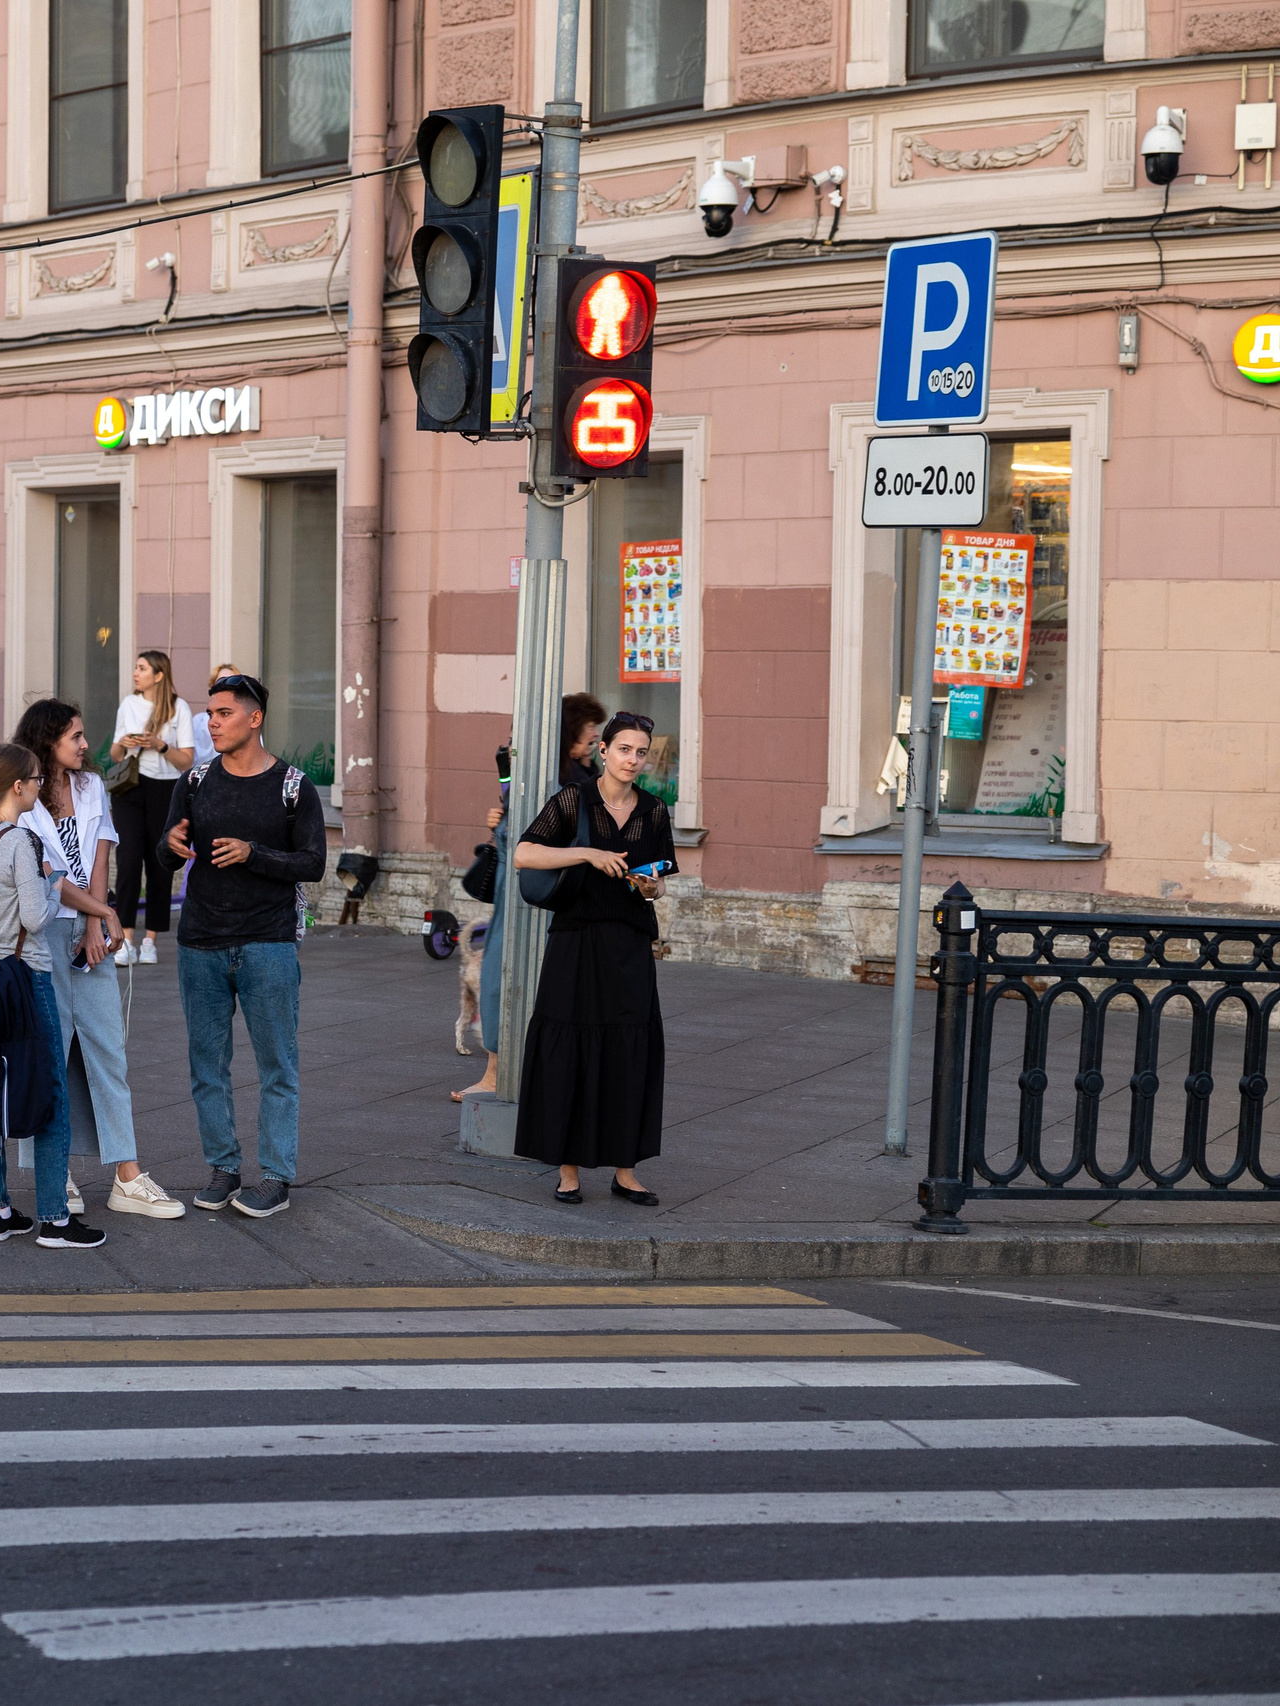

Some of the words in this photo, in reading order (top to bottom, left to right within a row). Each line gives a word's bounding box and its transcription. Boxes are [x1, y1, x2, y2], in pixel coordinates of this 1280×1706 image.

[907, 262, 970, 401] P
[931, 374, 940, 388] 10
[942, 372, 953, 389] 15
[956, 370, 973, 390] 20
[130, 385, 251, 446] ДИКСИ
[874, 465, 976, 497] 8.00-20.00
[964, 535, 994, 546] ТОВАР
[995, 538, 1016, 548] ДНЯ
[949, 690, 980, 701] Работа
